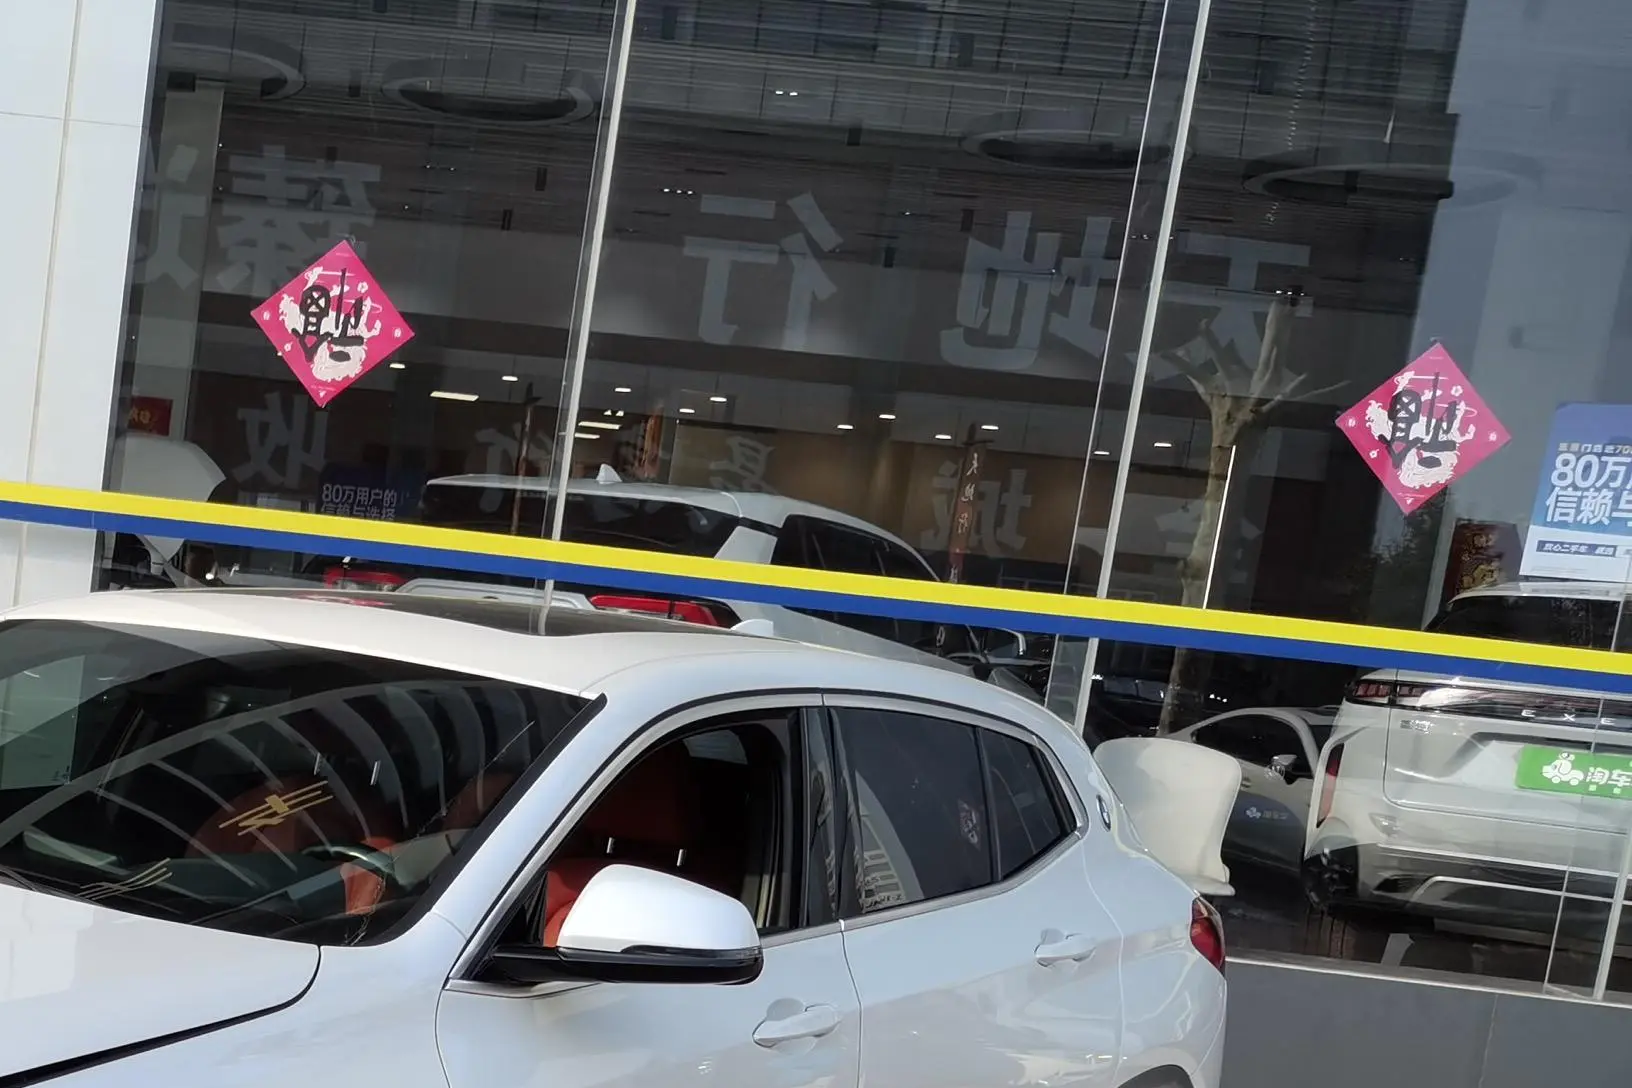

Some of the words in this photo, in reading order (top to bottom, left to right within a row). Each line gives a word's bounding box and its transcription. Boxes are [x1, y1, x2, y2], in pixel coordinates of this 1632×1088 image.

[1551, 453, 1632, 490] 80万
[322, 483, 397, 507] 80万用户的
